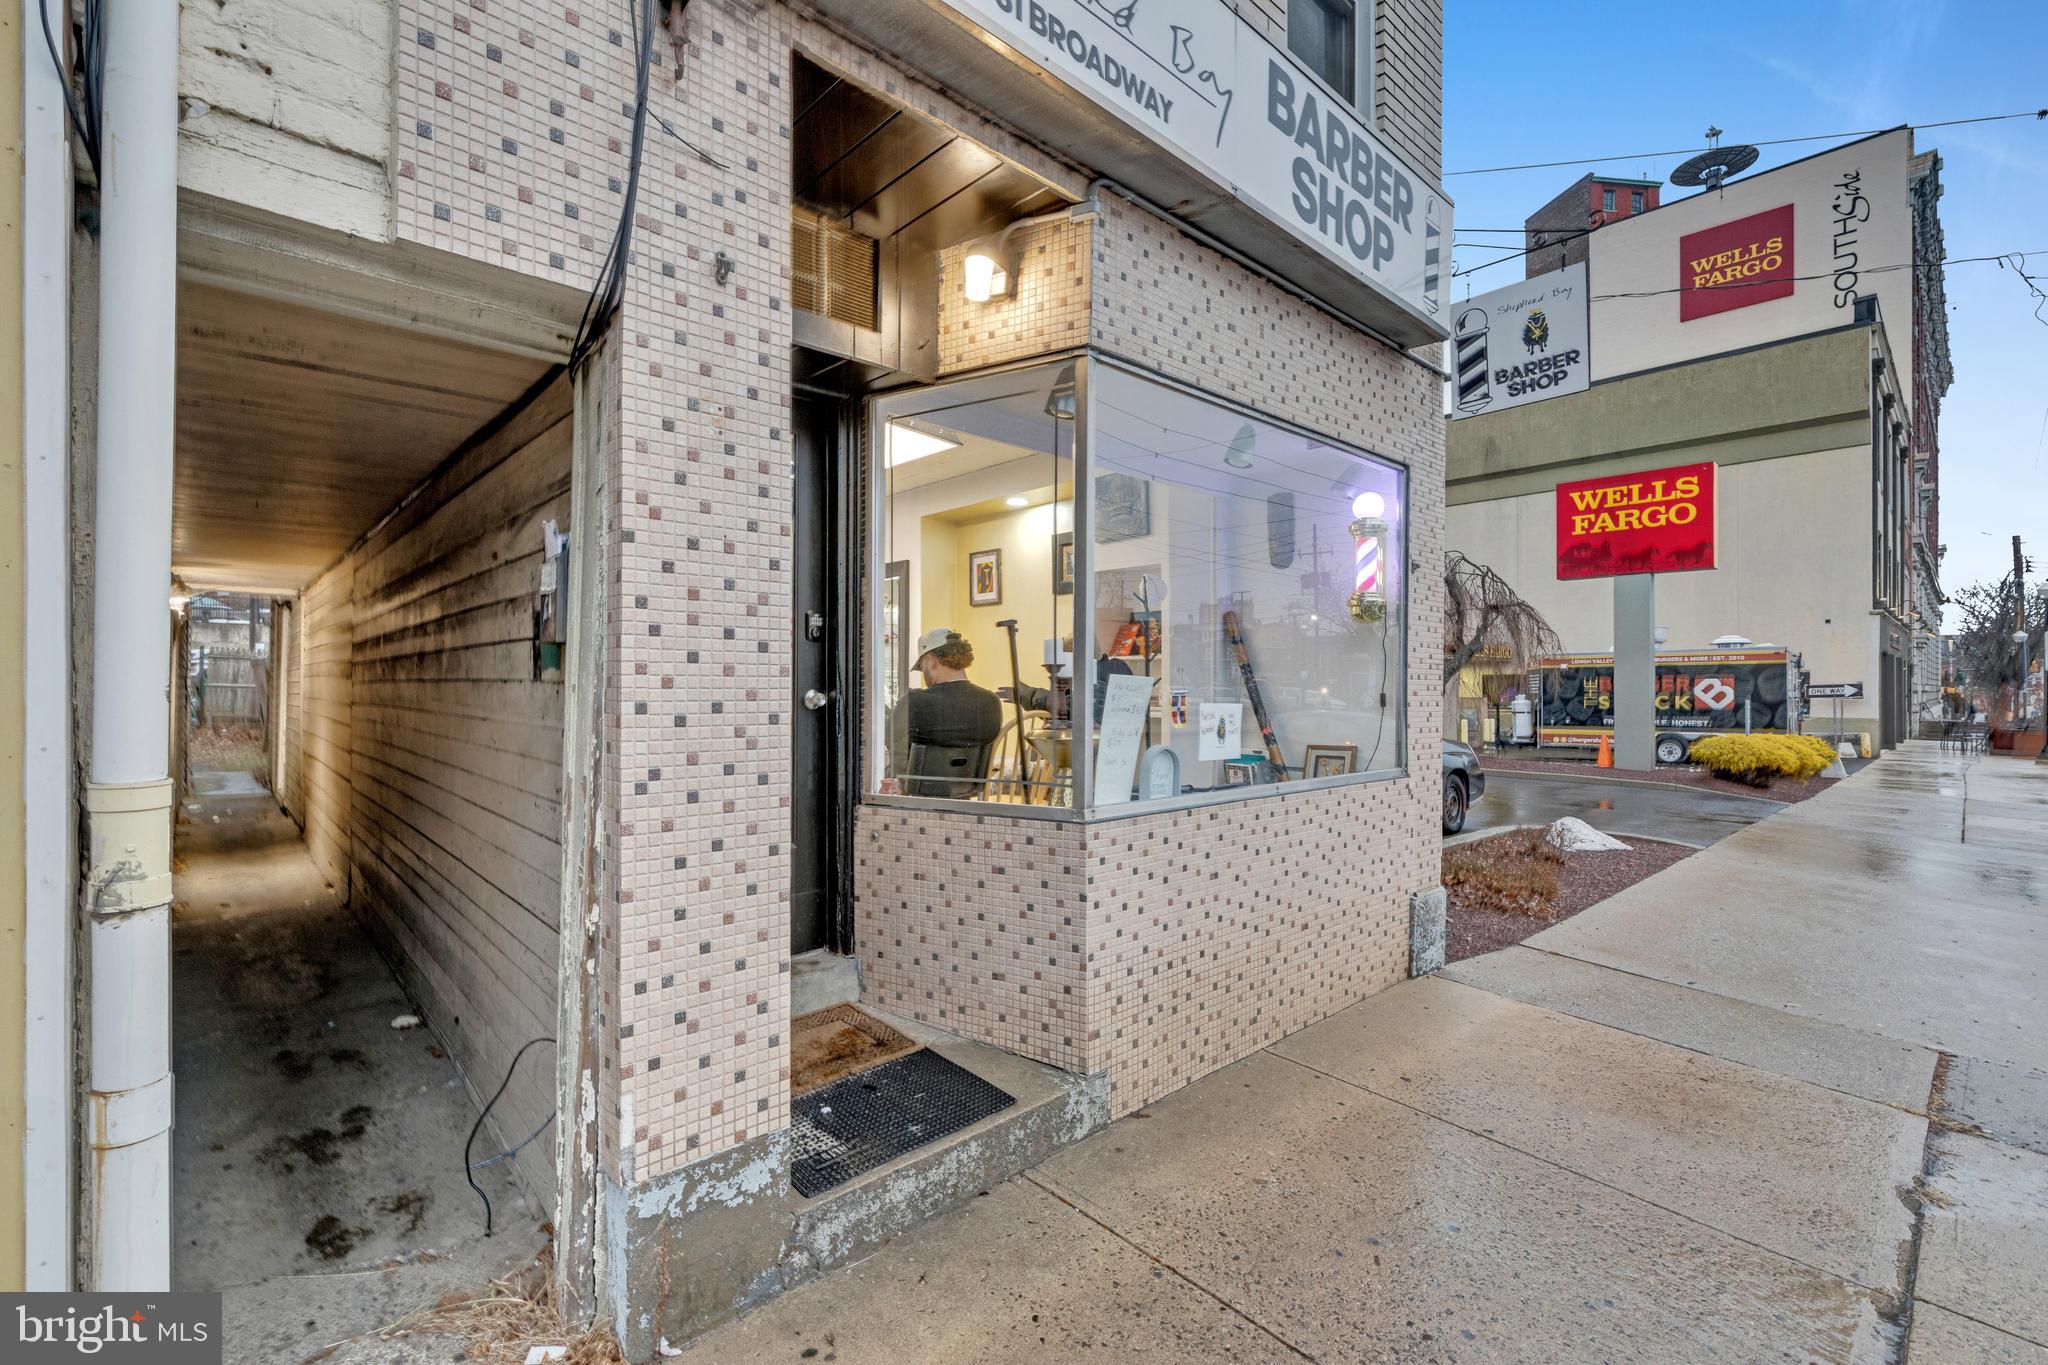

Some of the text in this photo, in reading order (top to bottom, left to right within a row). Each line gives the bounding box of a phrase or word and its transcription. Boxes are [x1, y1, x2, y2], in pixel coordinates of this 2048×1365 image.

[1029, 0, 1174, 124] BROADWAY
[1268, 57, 1413, 235] BARBER
[1292, 156, 1395, 272] SHOP
[1690, 236, 1783, 274] WELLS
[1692, 255, 1783, 291] FARGO
[1494, 349, 1580, 385] BARBER
[1507, 369, 1568, 397] SHOP
[1569, 475, 1700, 512] WELLS
[1571, 502, 1697, 536] FARGO
[1583, 675, 1599, 709] THE
[1829, 687, 1845, 695] WAY
